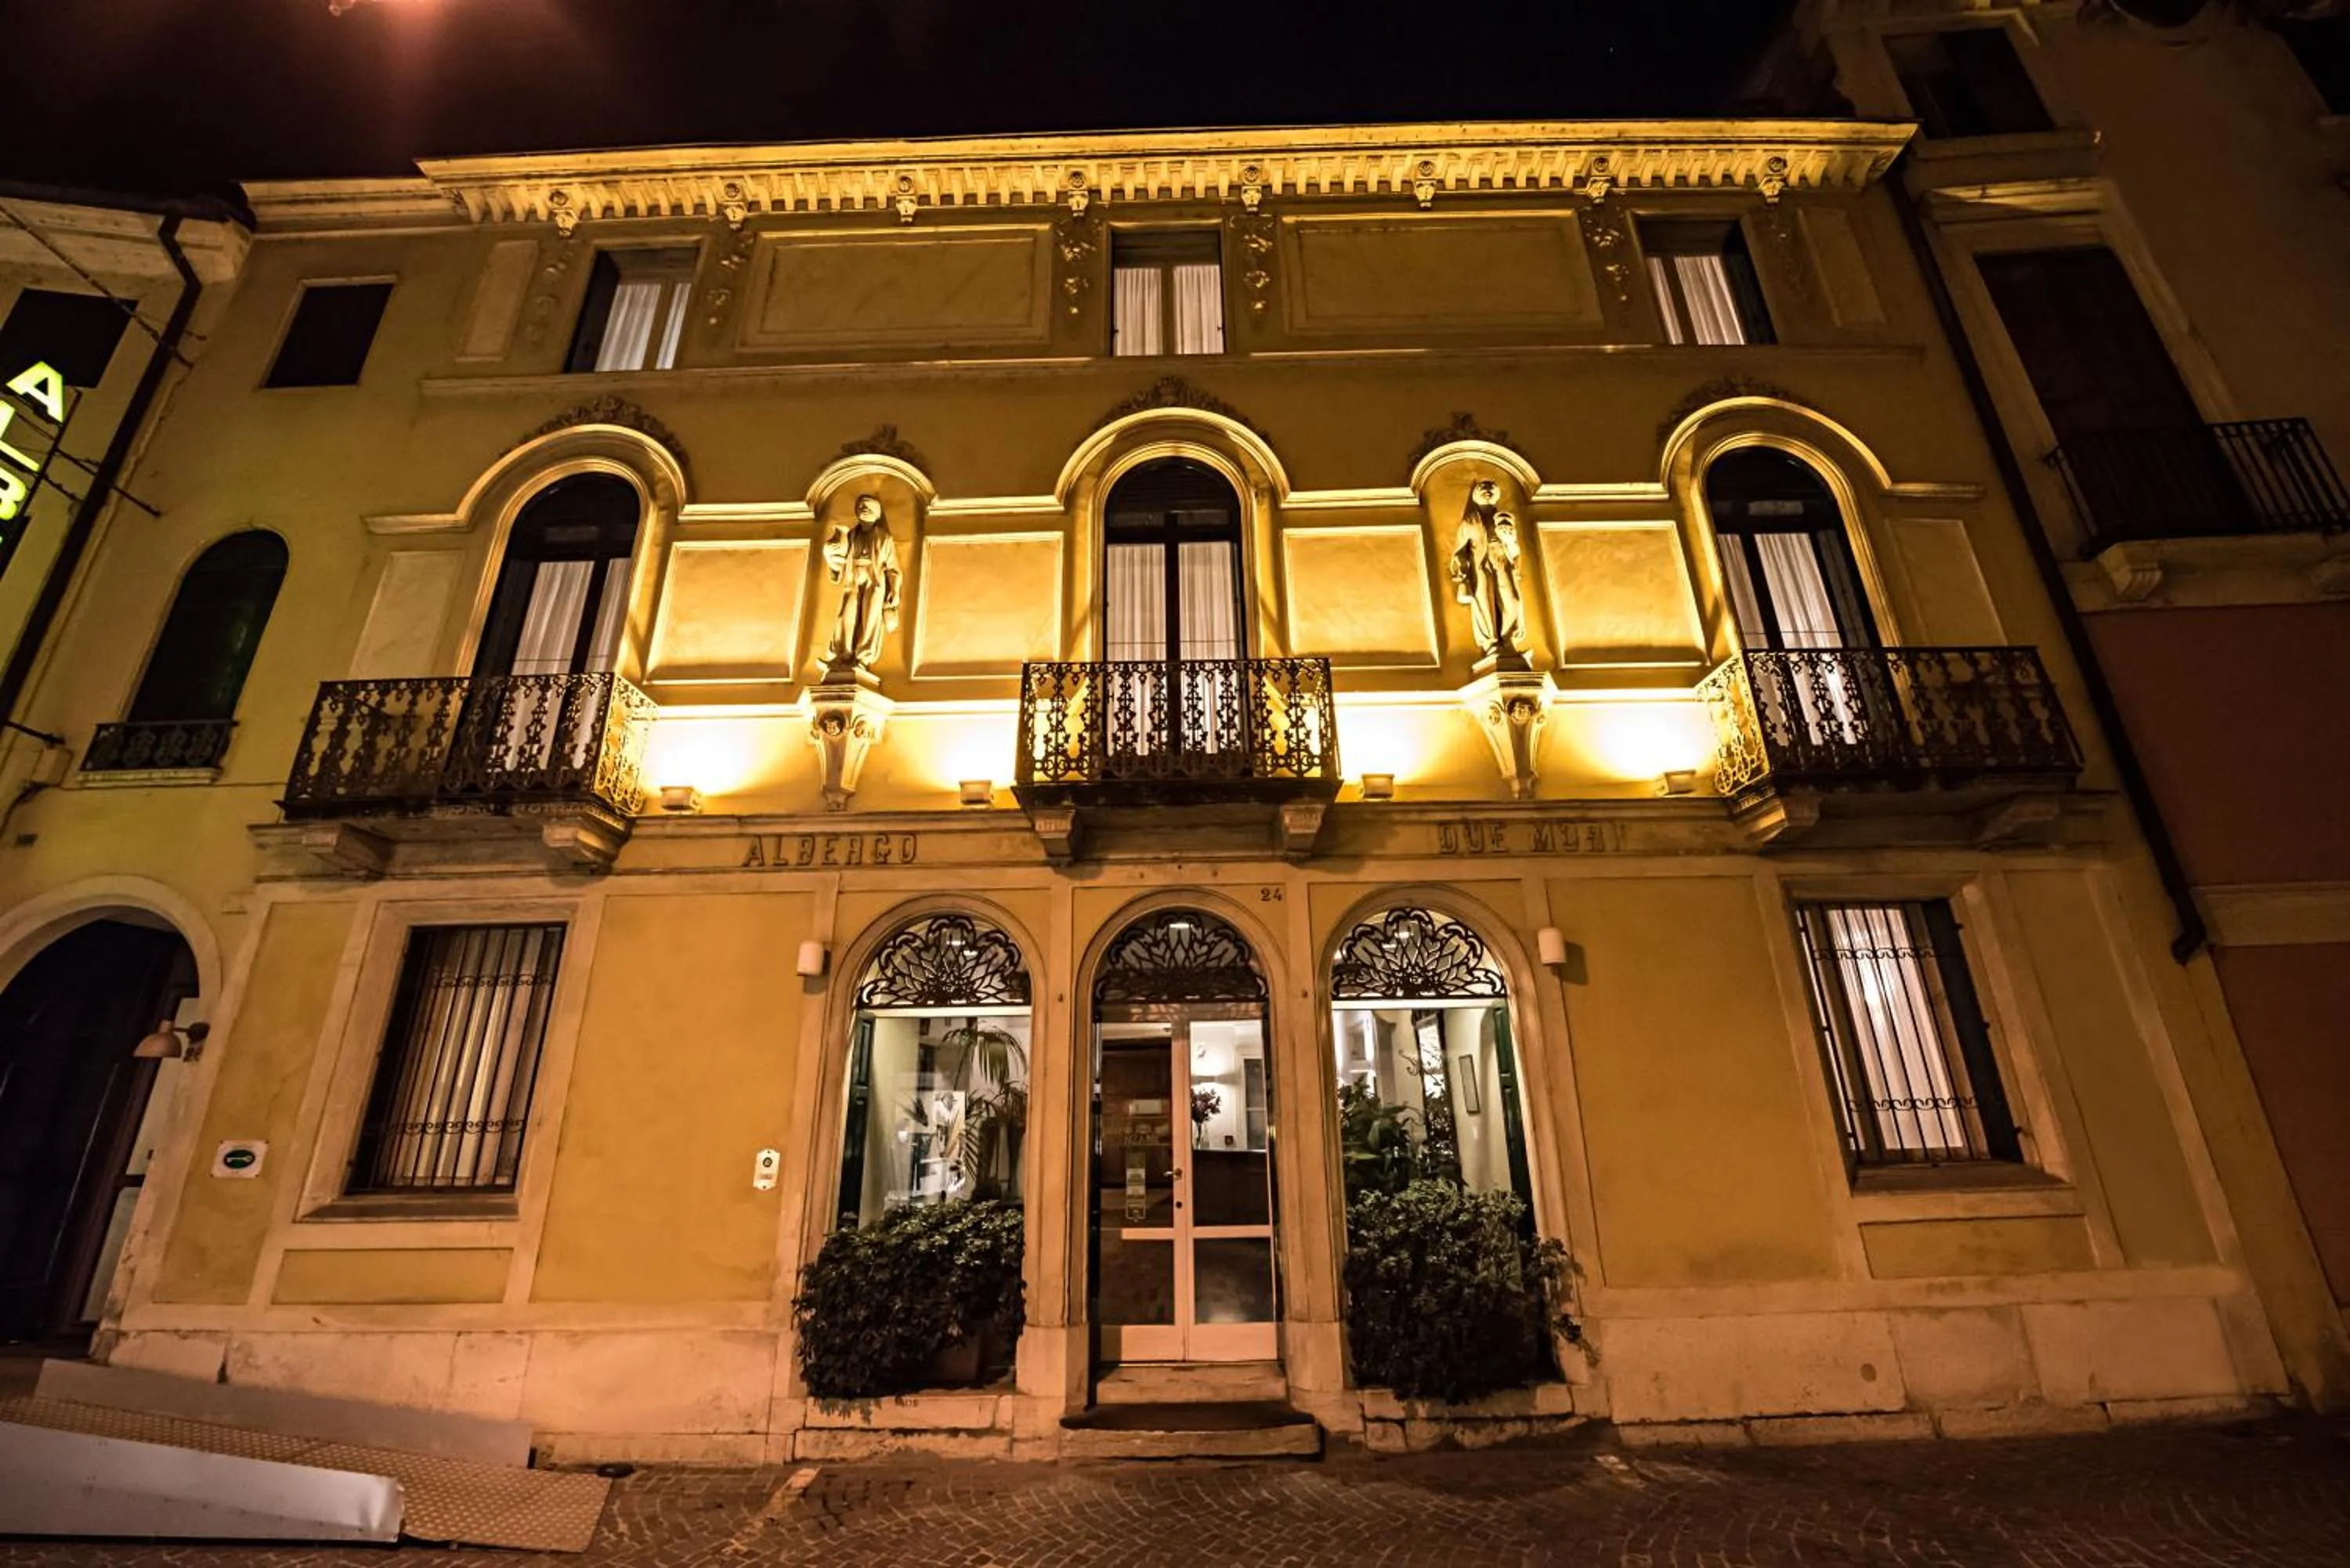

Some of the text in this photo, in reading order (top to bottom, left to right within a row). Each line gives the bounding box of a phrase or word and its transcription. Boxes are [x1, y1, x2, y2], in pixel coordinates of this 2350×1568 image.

[0, 360, 63, 540] ALB
[742, 832, 918, 867] ALBERGO
[1437, 818, 1509, 854] DUE
[1260, 887, 1282, 901] 24
